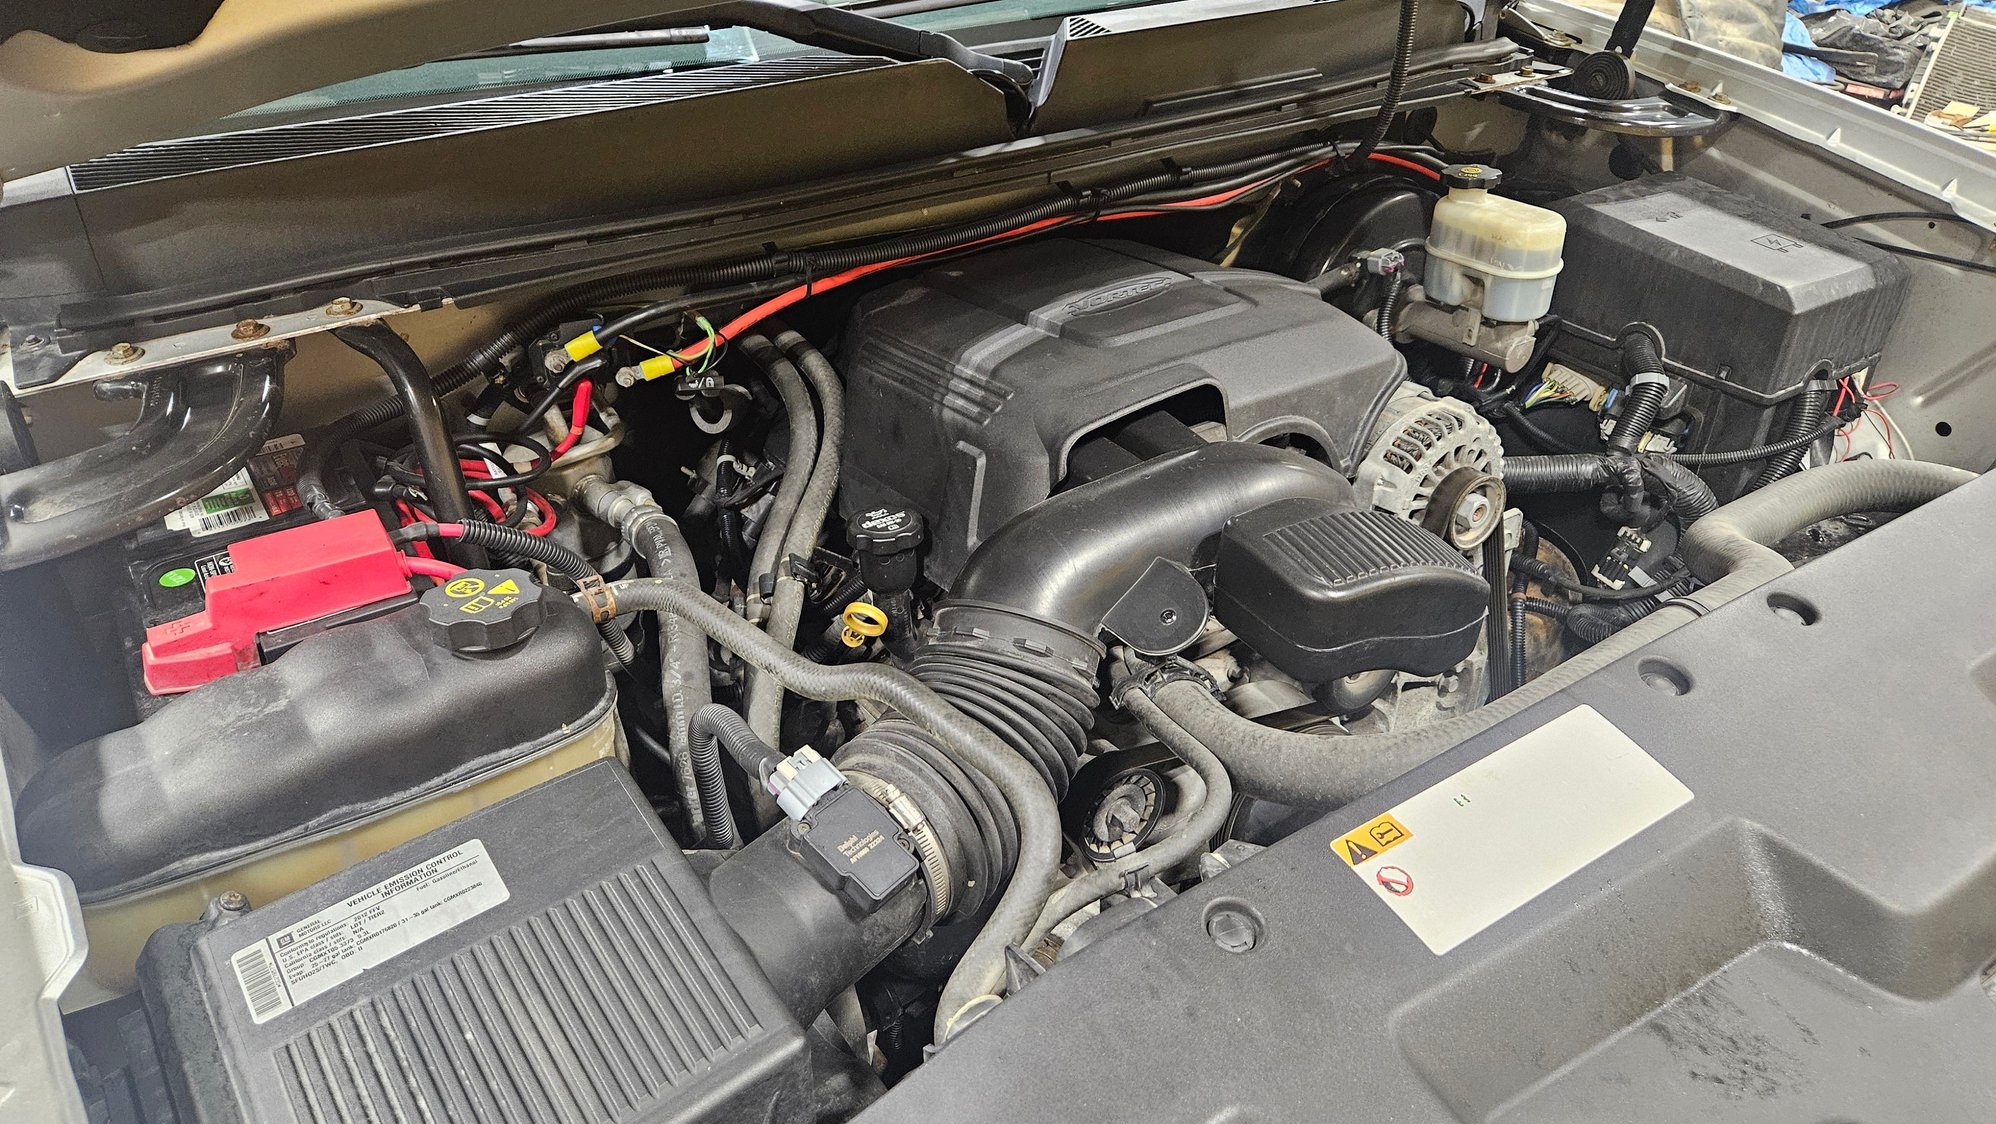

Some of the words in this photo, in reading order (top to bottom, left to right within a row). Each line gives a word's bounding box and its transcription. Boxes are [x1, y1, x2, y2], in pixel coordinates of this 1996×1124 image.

[1067, 277, 1171, 316] VORTEC
[837, 834, 858, 854] Delphi
[842, 829, 879, 857] Technologies
[346, 887, 382, 907] VEHICLE
[384, 868, 424, 890] EMISSION
[425, 850, 463, 870] CONTROL
[381, 868, 438, 898] INFORMATION
[416, 883, 429, 891] Fuel:
[432, 859, 478, 884] Gasoline/Ethanol
[296, 919, 321, 933] GENERAL
[296, 947, 309, 956] EPA
[310, 940, 325, 950] class
[368, 910, 384, 921] TIER2
[298, 924, 321, 938] MOTORS
[321, 919, 331, 927] LLC
[315, 923, 349, 941] regulations:
[353, 912, 368, 922] 2012
[369, 905, 380, 914] FFV
[284, 953, 312, 969] California
[313, 945, 328, 954] class
[352, 927, 364, 935] N/A
[288, 970, 305, 980] Evap:
[341, 945, 354, 953] tank:
[429, 902, 442, 910] tank:
[341, 950, 355, 960] OBD:
[286, 962, 305, 974] Group:
